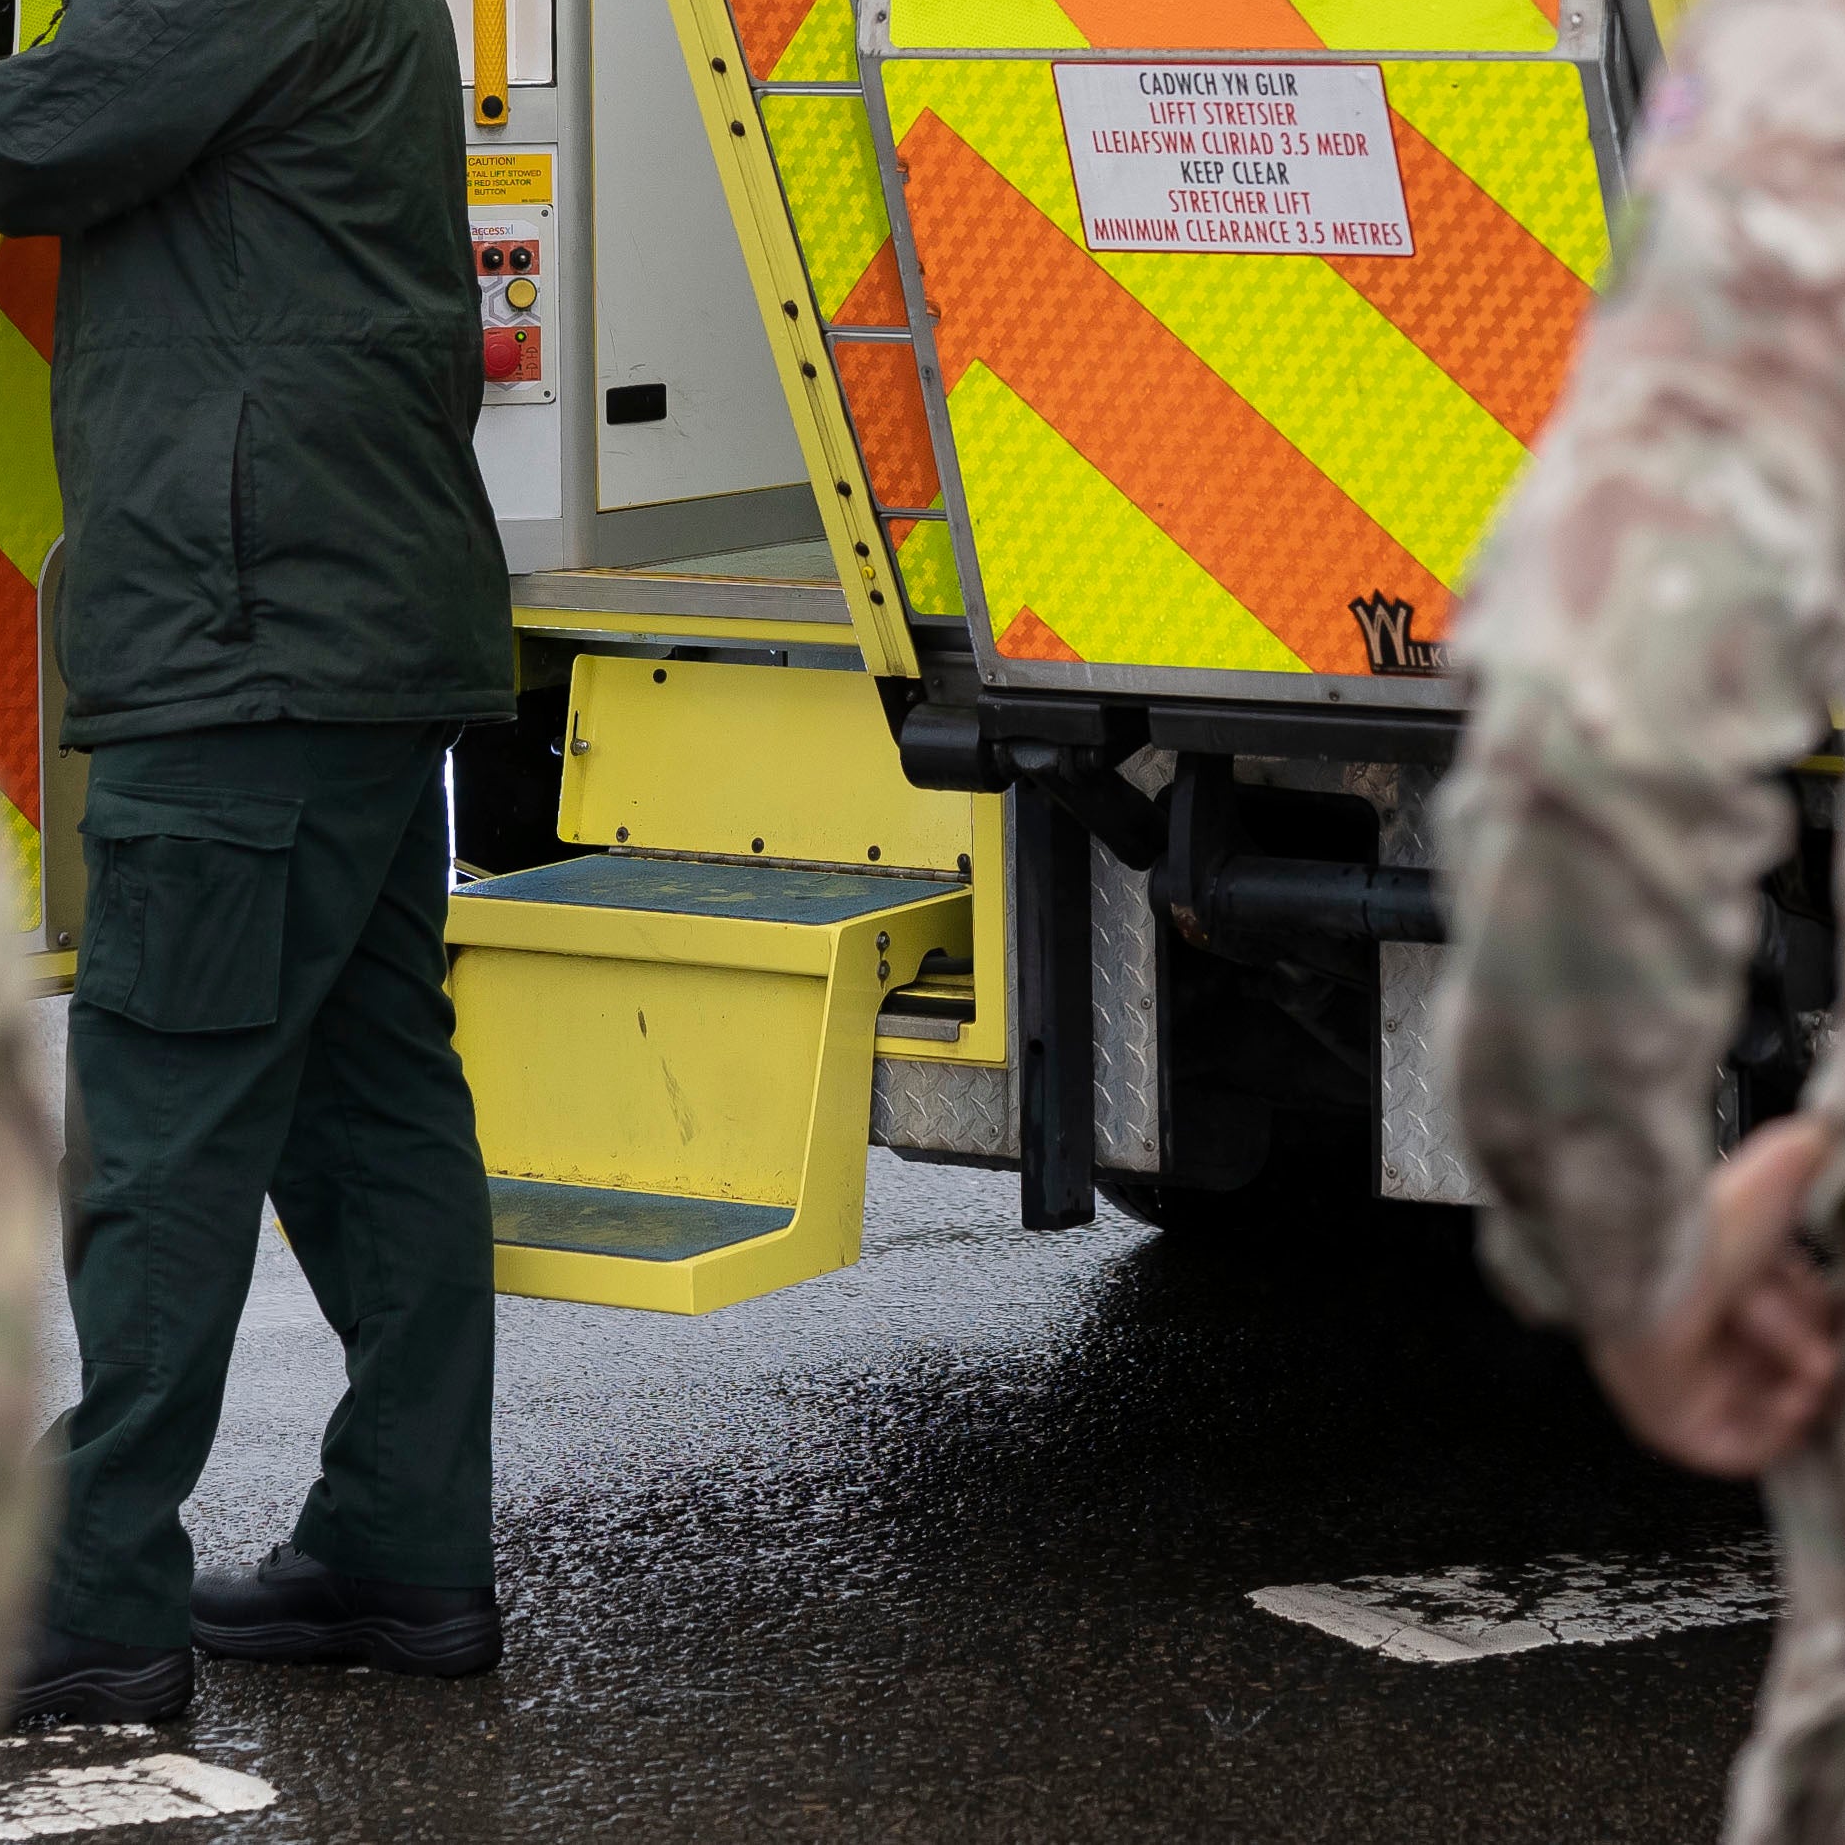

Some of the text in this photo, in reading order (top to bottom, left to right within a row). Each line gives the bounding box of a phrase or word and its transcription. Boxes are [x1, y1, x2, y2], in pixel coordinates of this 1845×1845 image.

[1139, 72, 1299, 97] CADWCH YN GLIR
[1148, 101, 1298, 126] LIFFT STRETSIER
[1092, 130, 1369, 157] LLEIAFSWM CLIRIAD 3.5 MEDR
[468, 156, 516, 166] CAUTION!
[472, 170, 488, 178] TAIL
[489, 170, 506, 178] LIFT
[508, 169, 542, 177] STOWED
[1180, 160, 1290, 185] KEEP CLEAR
[1167, 189, 1312, 215] STRETCHER LIFT
[471, 224, 514, 236] accessxl
[1093, 218, 1403, 246] MINIMUM CLEARANCE 3.5 METRES
